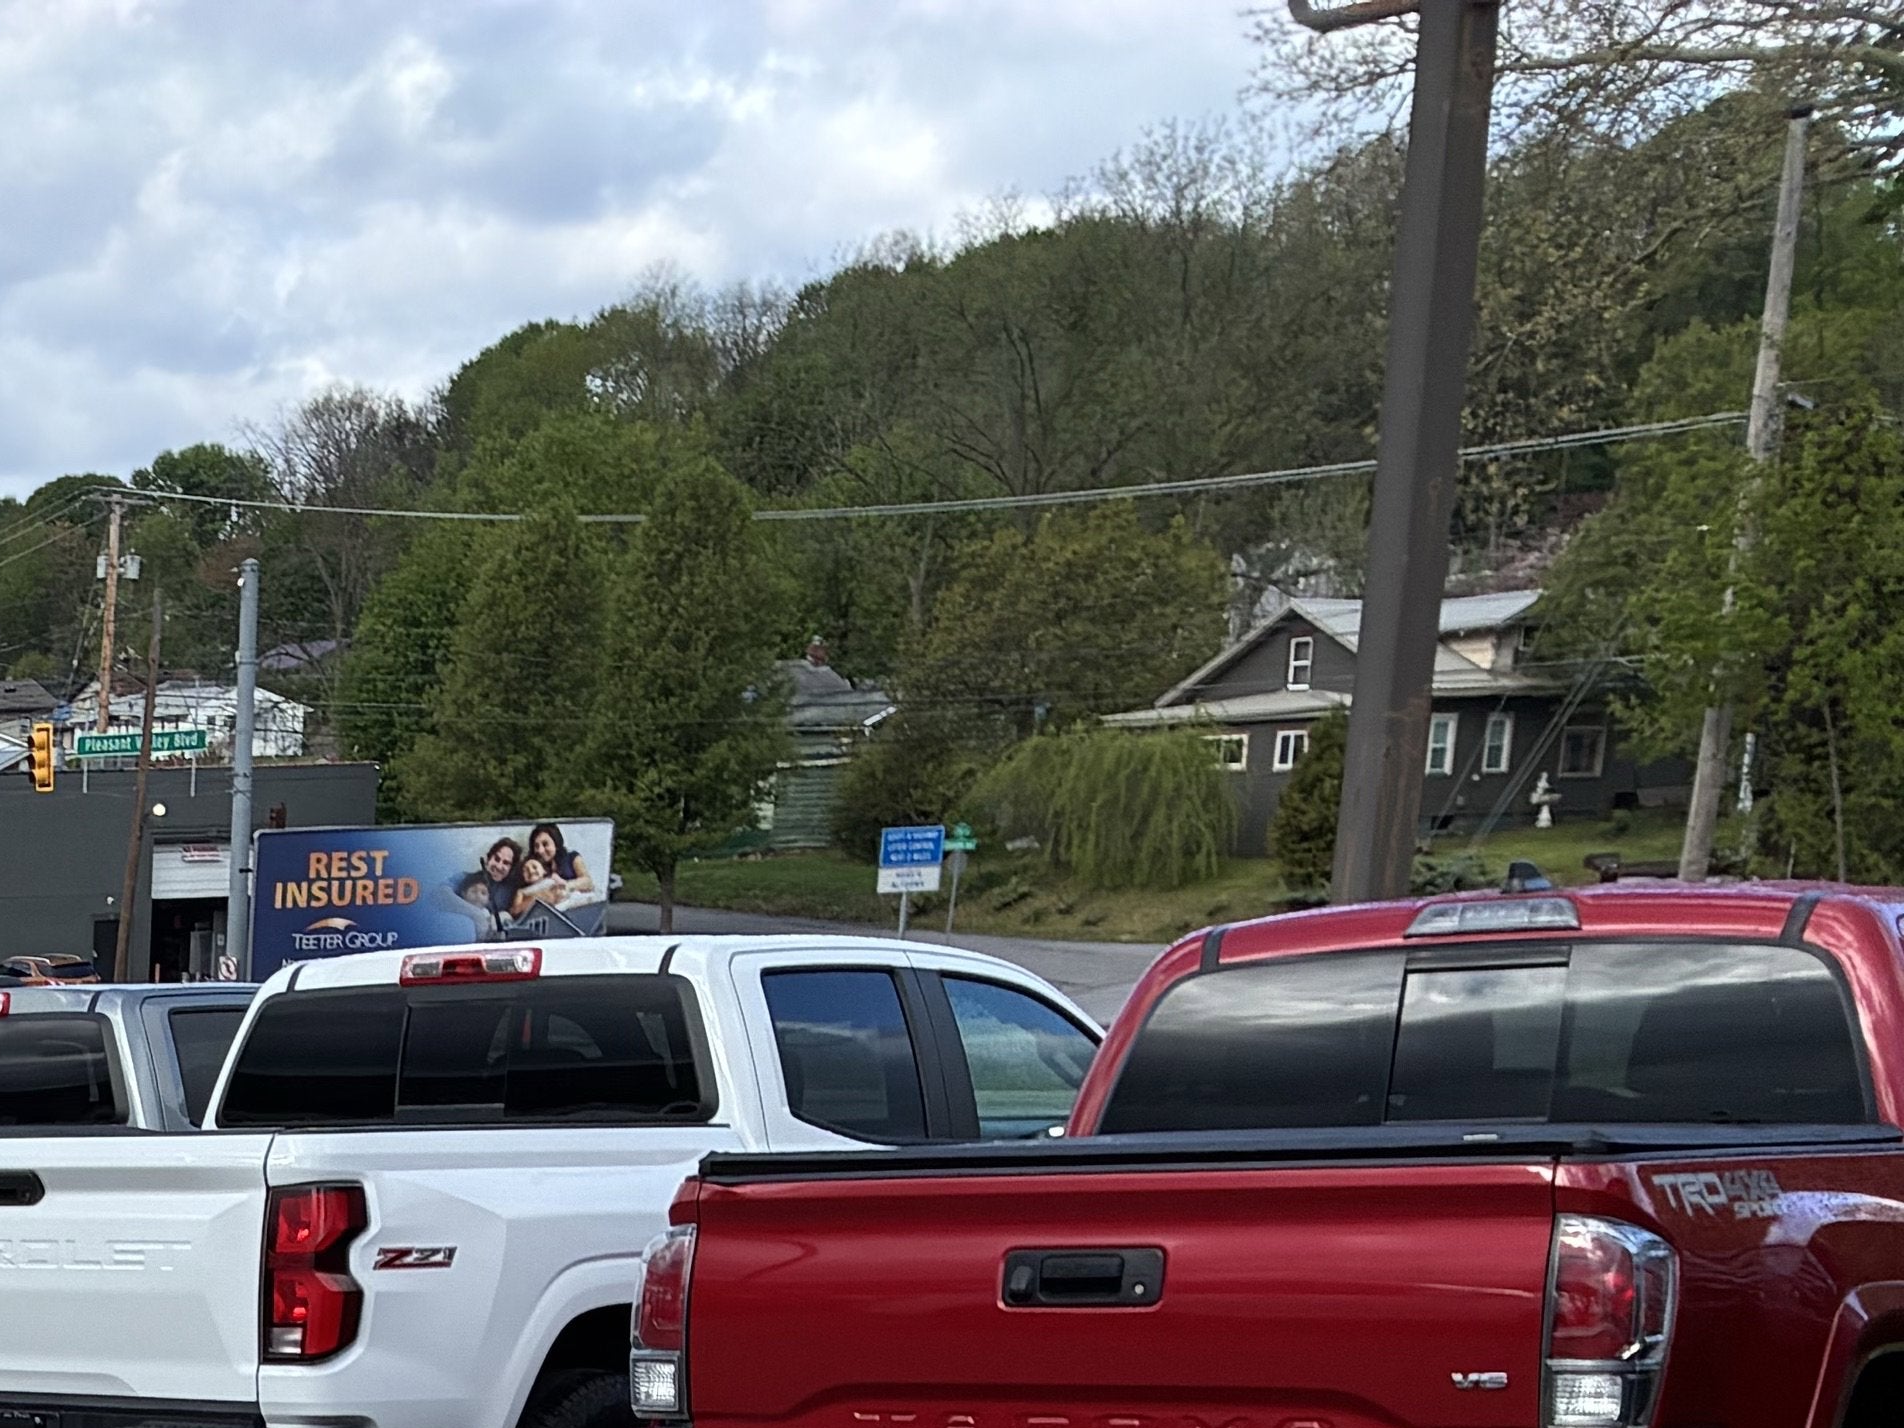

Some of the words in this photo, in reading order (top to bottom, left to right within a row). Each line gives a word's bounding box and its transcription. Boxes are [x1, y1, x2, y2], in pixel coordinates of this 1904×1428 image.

[84, 736, 132, 752] Pleasant
[174, 732, 198, 748] Blvd
[308, 849, 390, 879] REST
[273, 877, 421, 910] INSURED
[292, 932, 344, 950] TEETER
[345, 930, 398, 948] GROUP
[1651, 1172, 1729, 1218] TRD
[373, 1246, 457, 1271] Z71
[1451, 1371, 1508, 1390] V6
